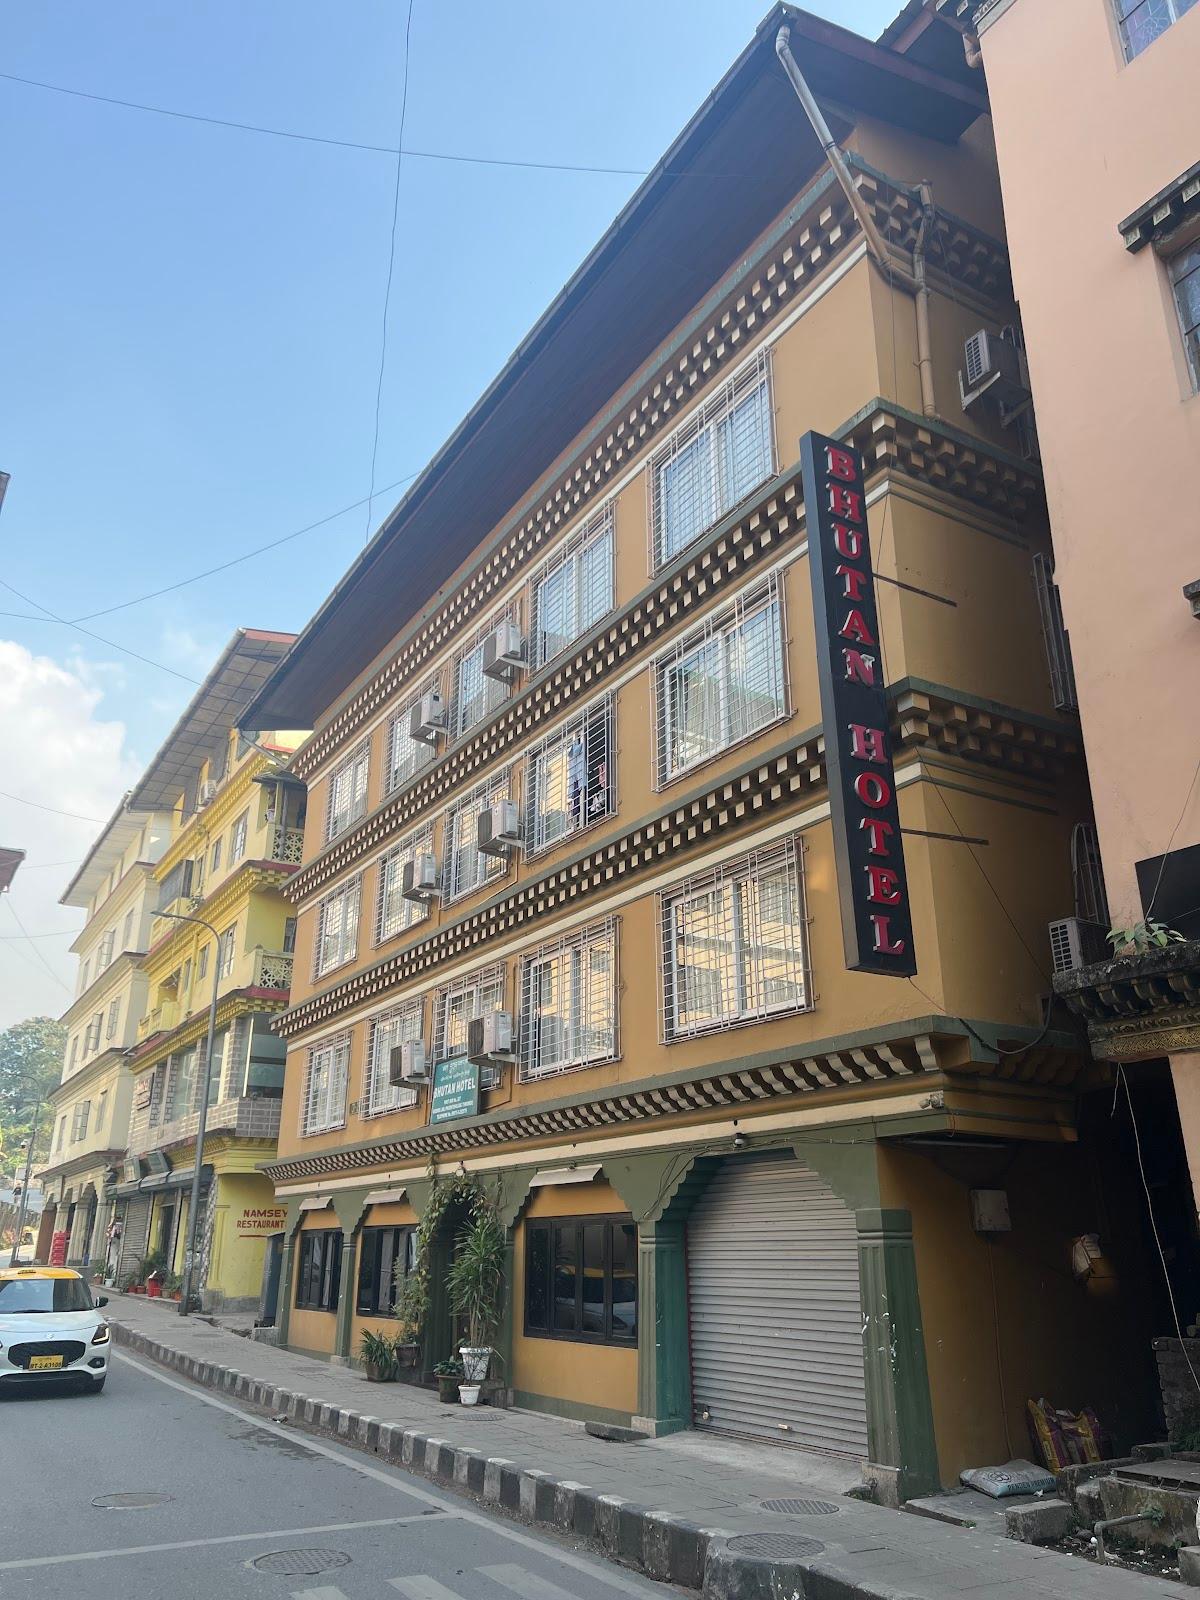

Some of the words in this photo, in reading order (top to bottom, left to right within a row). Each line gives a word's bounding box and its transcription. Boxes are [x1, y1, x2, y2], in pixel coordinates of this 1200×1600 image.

[824, 445, 875, 687] BHUTAN
[847, 723, 904, 955] HOTEL
[433, 1084, 456, 1099] BHUTAN
[456, 1077, 475, 1093] HOTEL
[236, 1220, 285, 1229] RESTAURANT
[243, 1209, 288, 1218] NAMSEY
